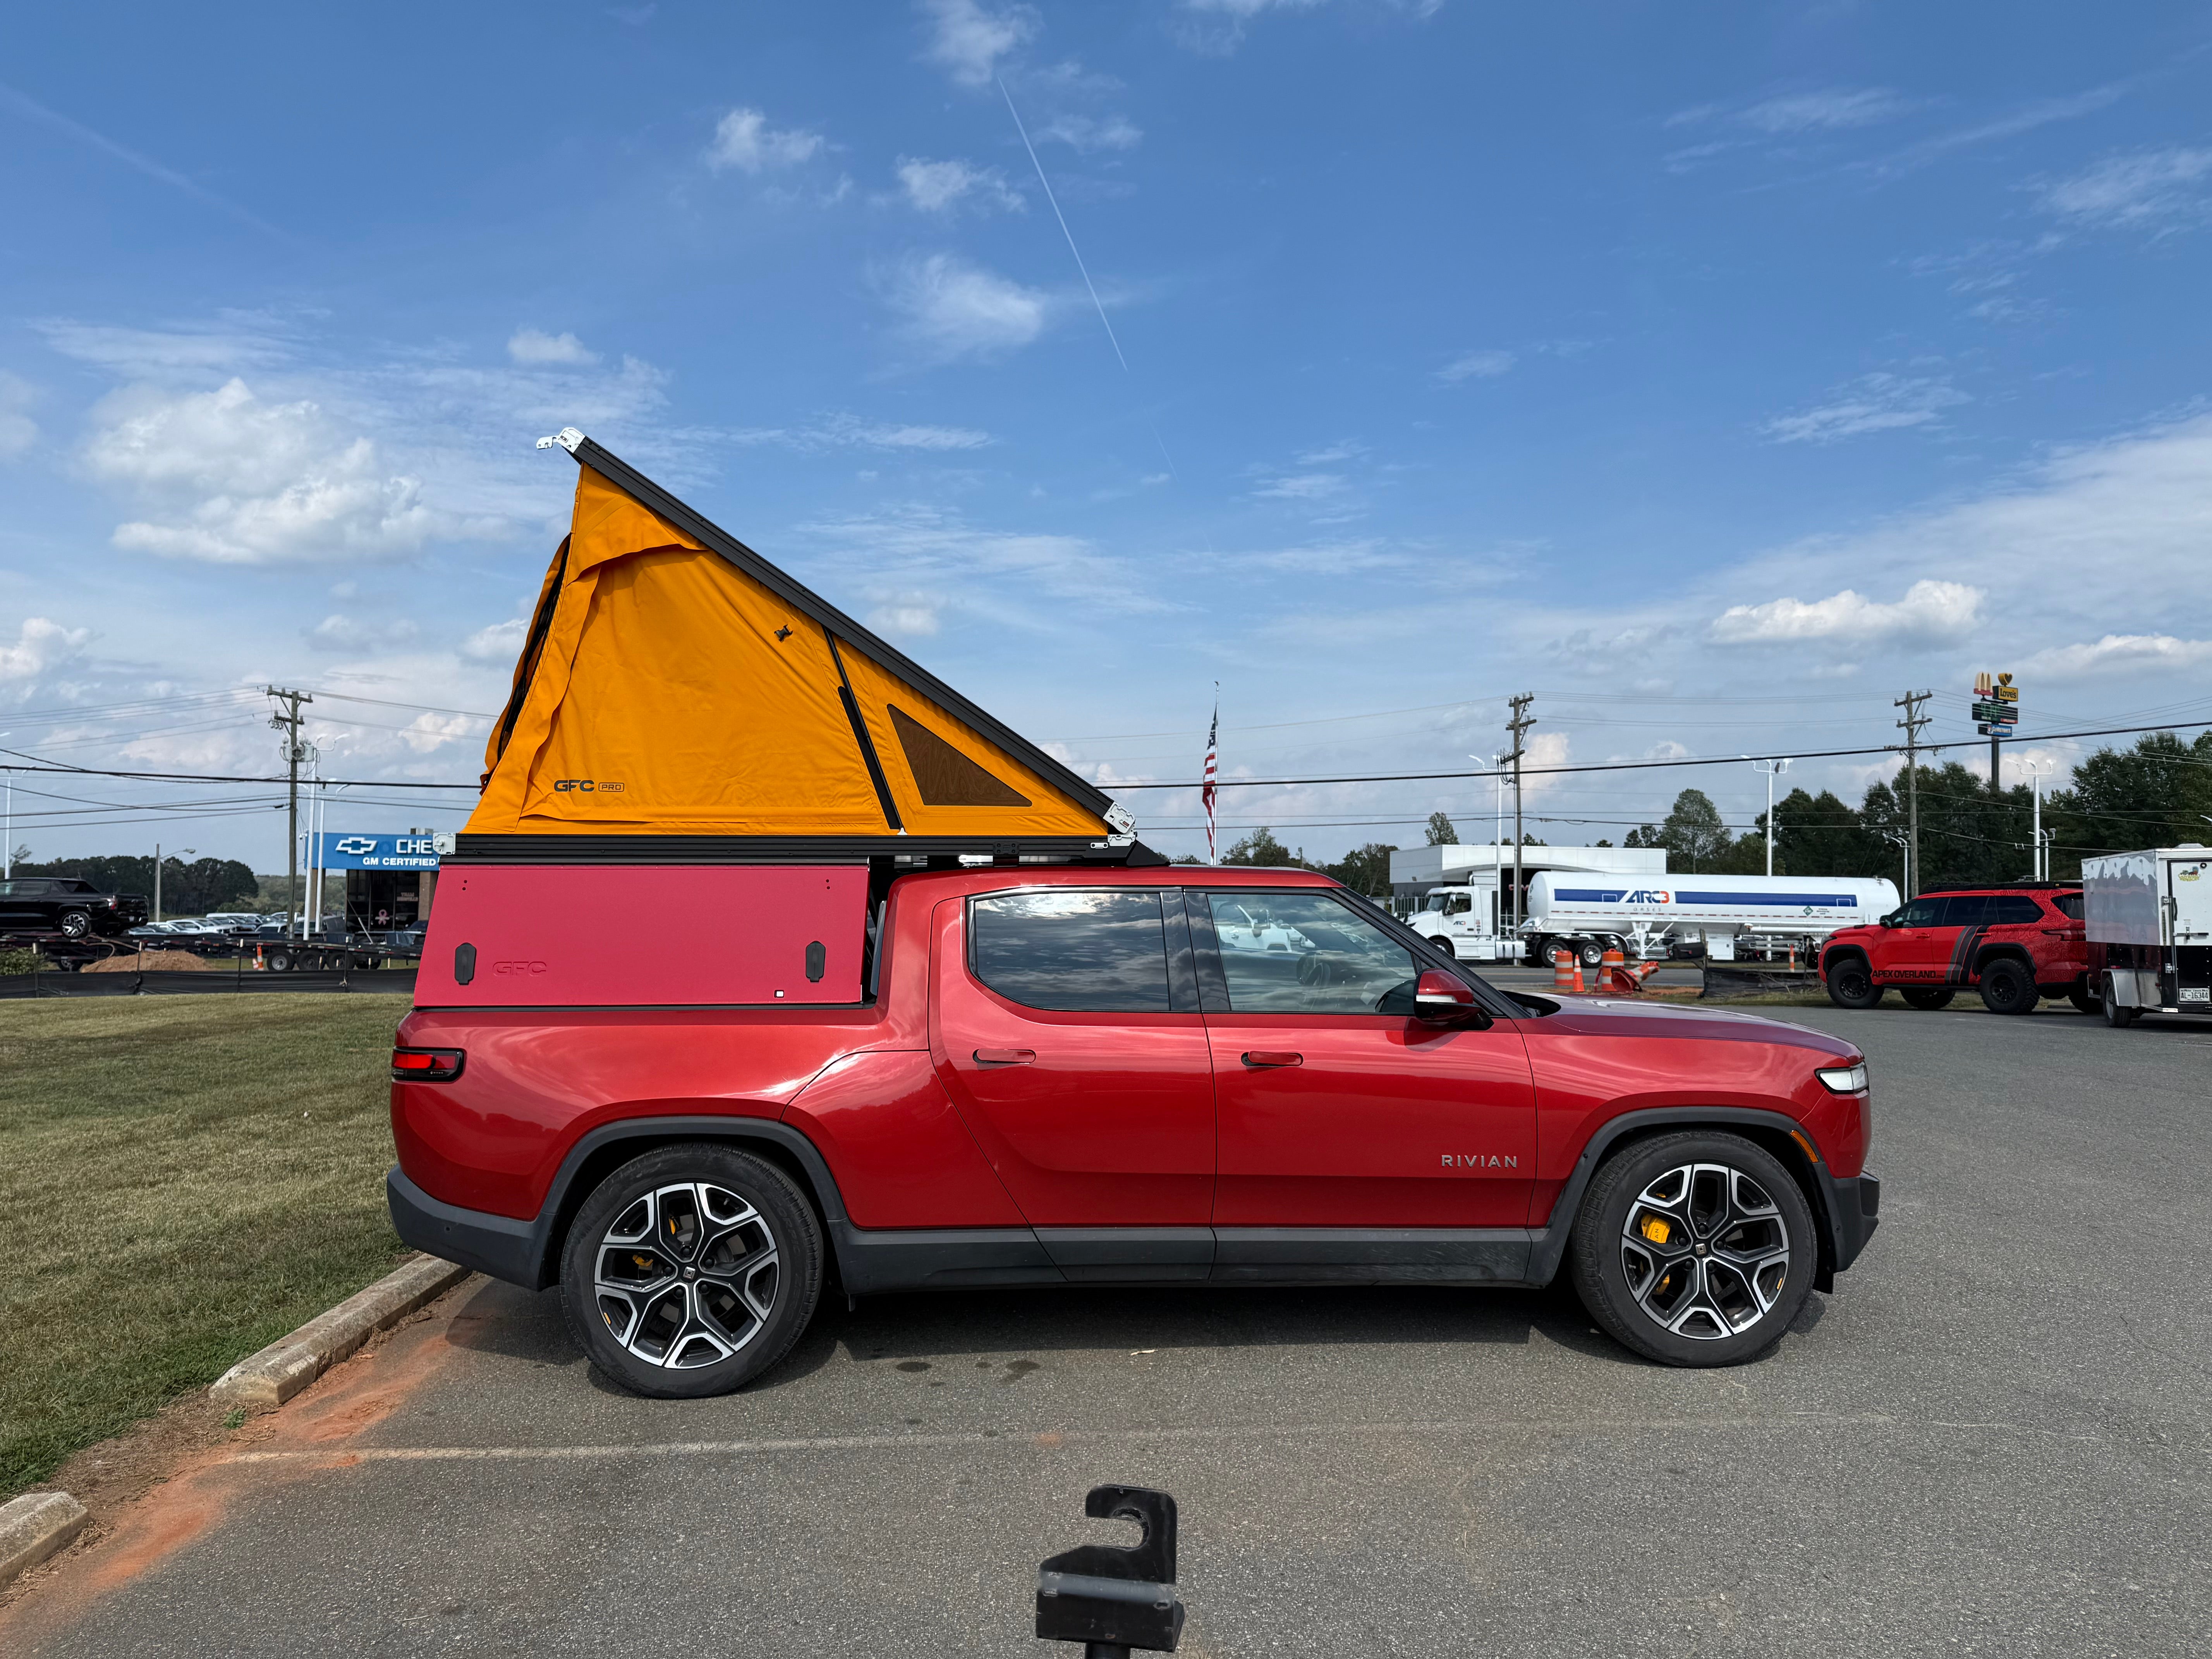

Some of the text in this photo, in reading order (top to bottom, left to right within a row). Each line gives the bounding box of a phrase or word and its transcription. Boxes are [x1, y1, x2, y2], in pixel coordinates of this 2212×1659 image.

[2000, 688, 2016, 698] Love's
[554, 780, 594, 792] GFC
[396, 839, 433, 854] CHE
[363, 857, 436, 866] GM CERTIFIED
[1625, 890, 1669, 903] ARC3
[493, 961, 547, 976] GFC
[1872, 970, 1894, 978] APEX
[1441, 1155, 1517, 1168] RIVIAN
